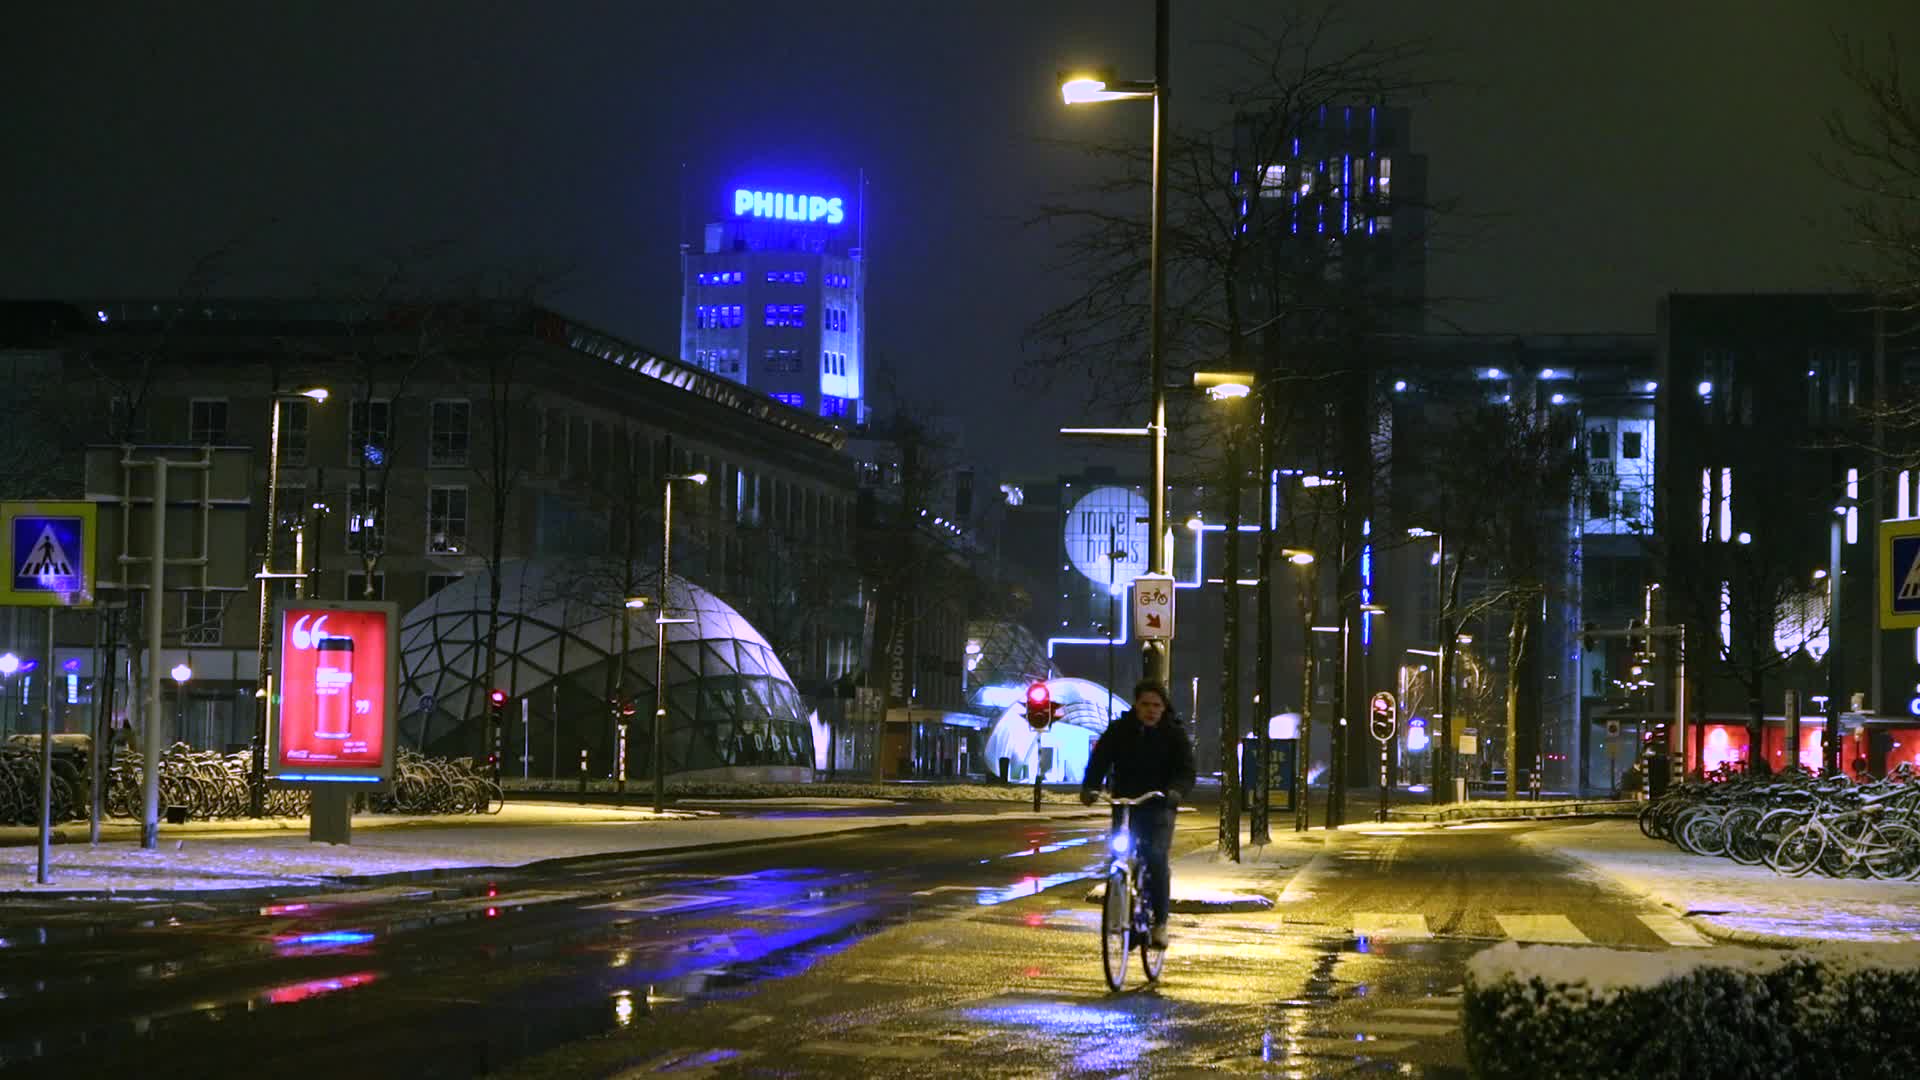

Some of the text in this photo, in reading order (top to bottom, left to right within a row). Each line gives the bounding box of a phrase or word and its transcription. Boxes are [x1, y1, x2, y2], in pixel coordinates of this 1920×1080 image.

[735, 189, 843, 224] PHILIPS
[1081, 511, 1130, 535] innel
[1086, 539, 1139, 563] hoels
